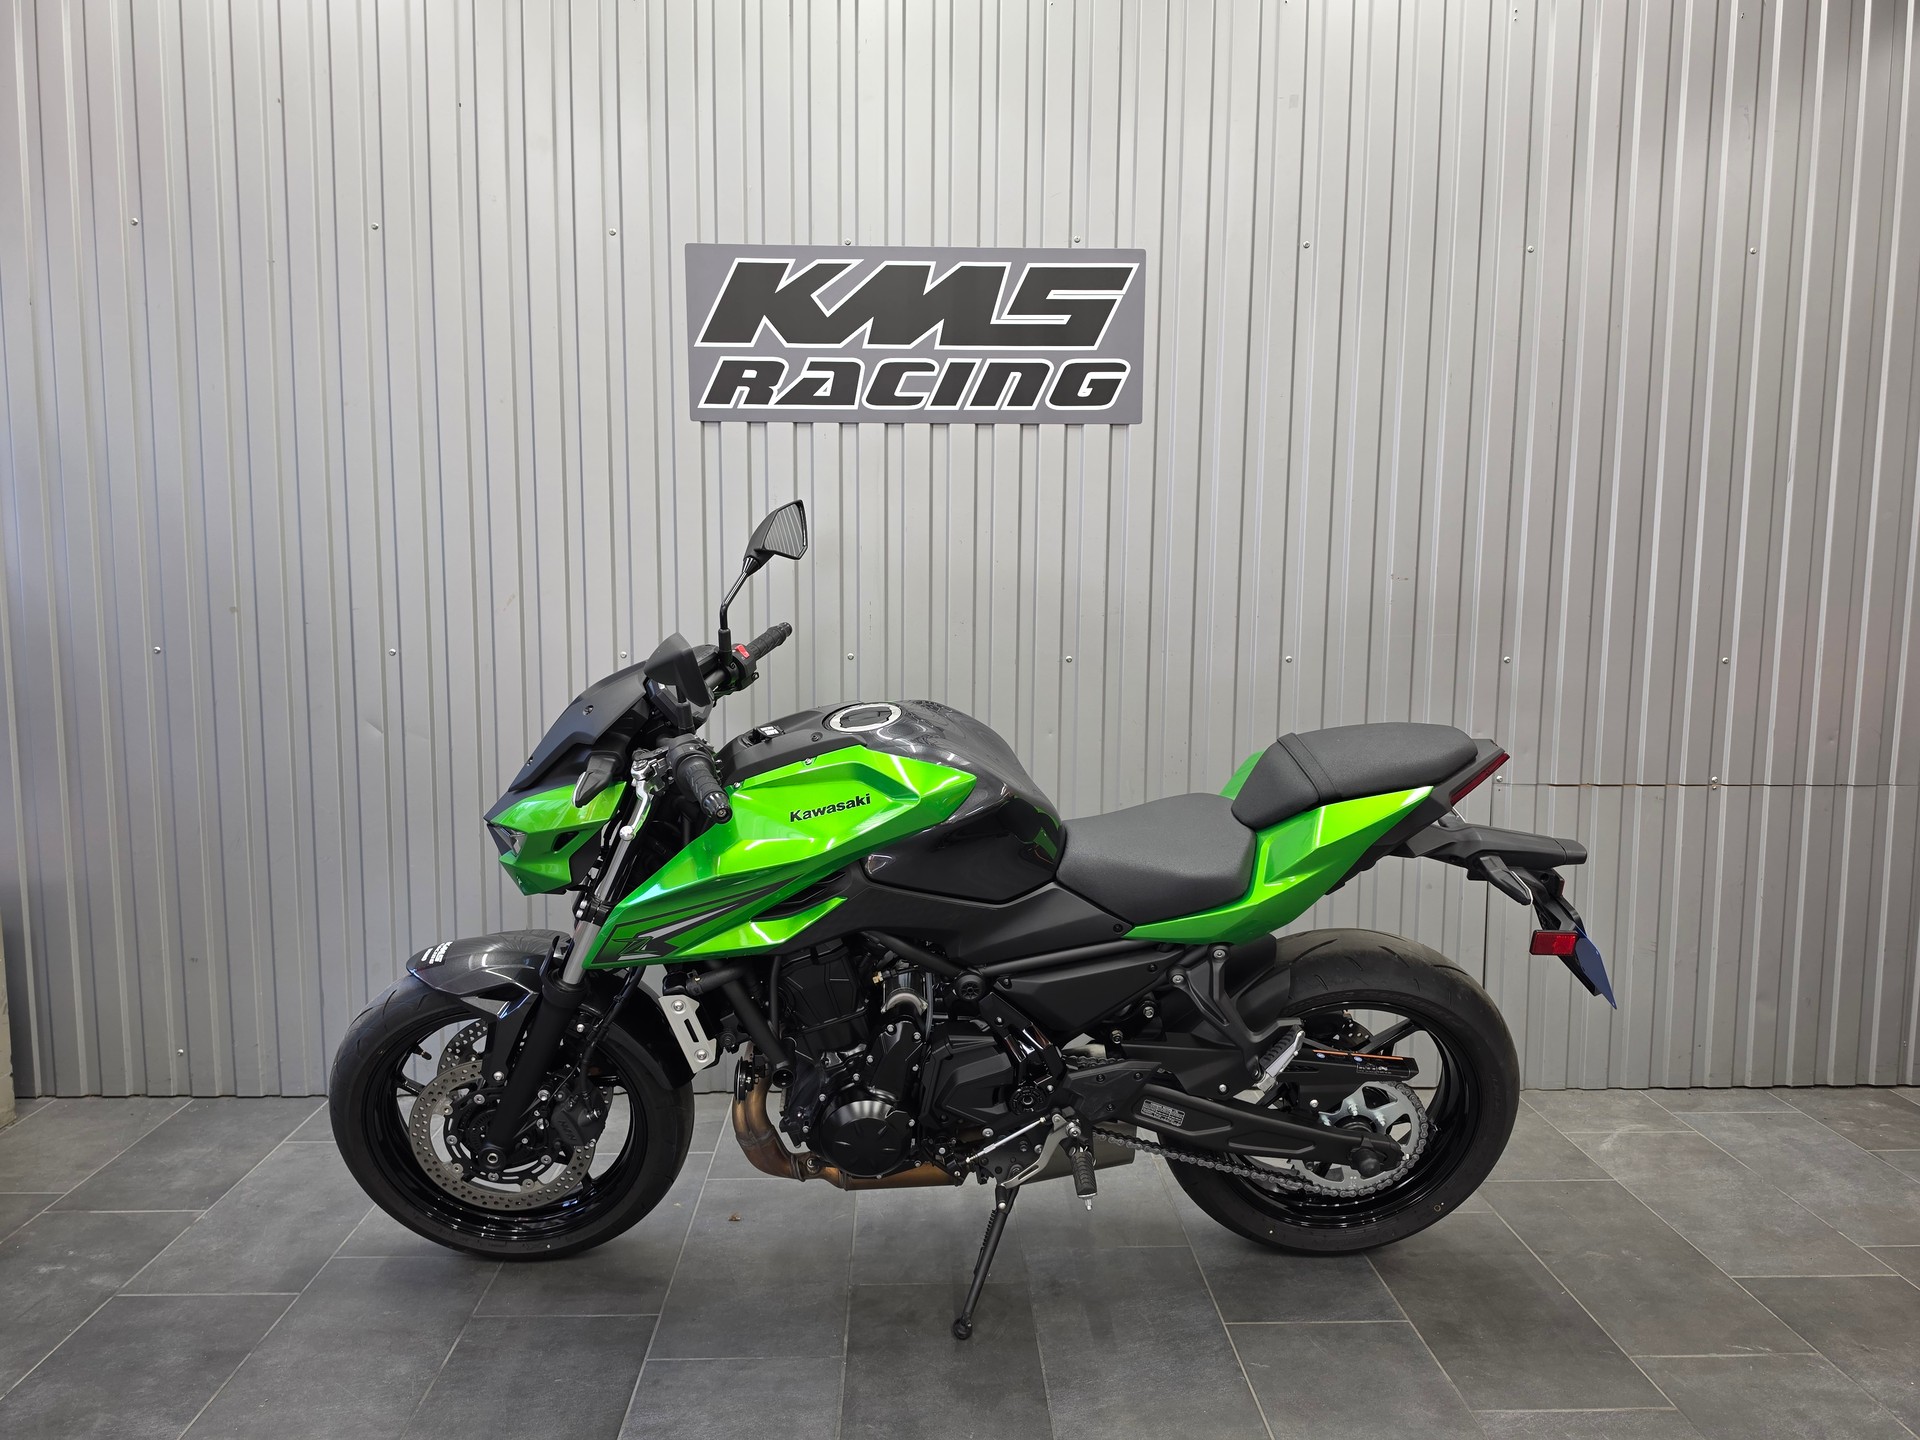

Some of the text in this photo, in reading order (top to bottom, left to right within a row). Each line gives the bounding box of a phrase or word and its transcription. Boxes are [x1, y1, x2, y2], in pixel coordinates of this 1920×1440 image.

[694, 257, 1140, 350] KMS
[698, 356, 1131, 410] RACING
[789, 793, 871, 822] Kawasaki
